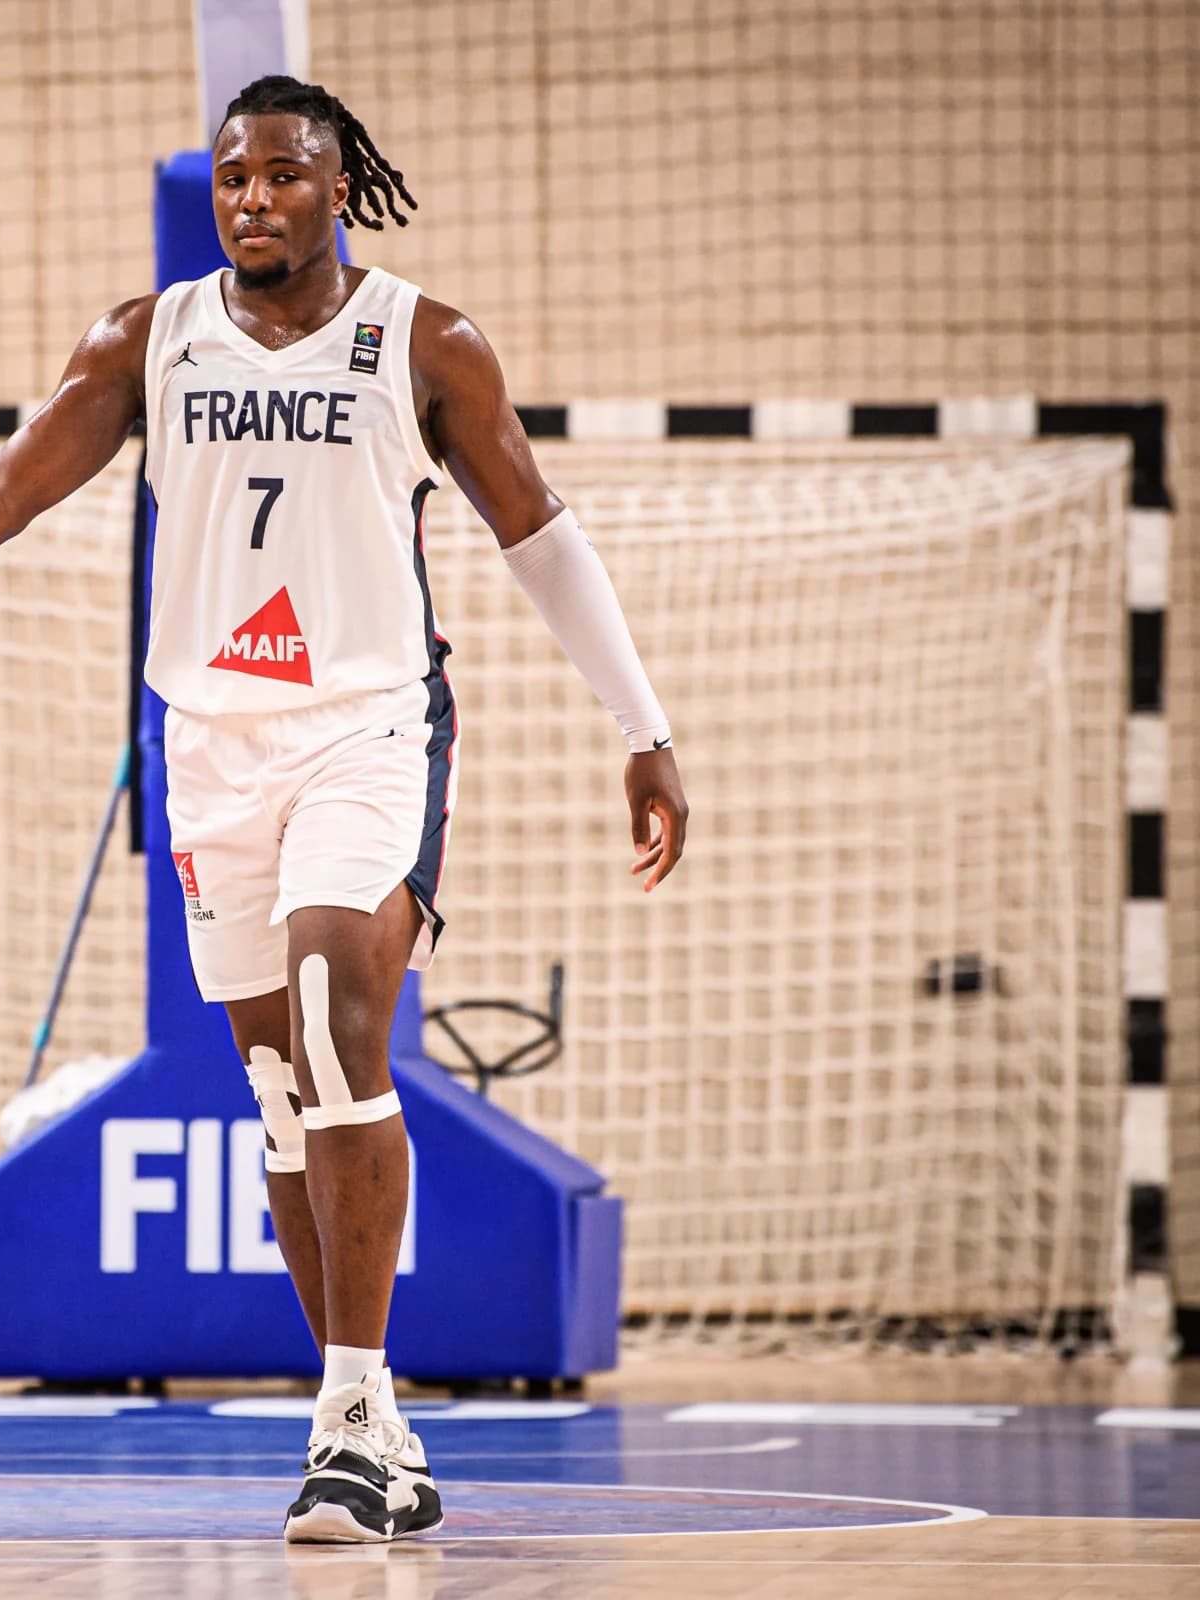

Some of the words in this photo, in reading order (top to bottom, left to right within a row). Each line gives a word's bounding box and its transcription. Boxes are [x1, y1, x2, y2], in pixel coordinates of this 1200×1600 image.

[355, 350, 375, 361] FIBA
[184, 390, 357, 445] FRANCE
[248, 477, 284, 550] 7
[222, 633, 305, 662] MAIF
[101, 1118, 416, 1275] FIB
